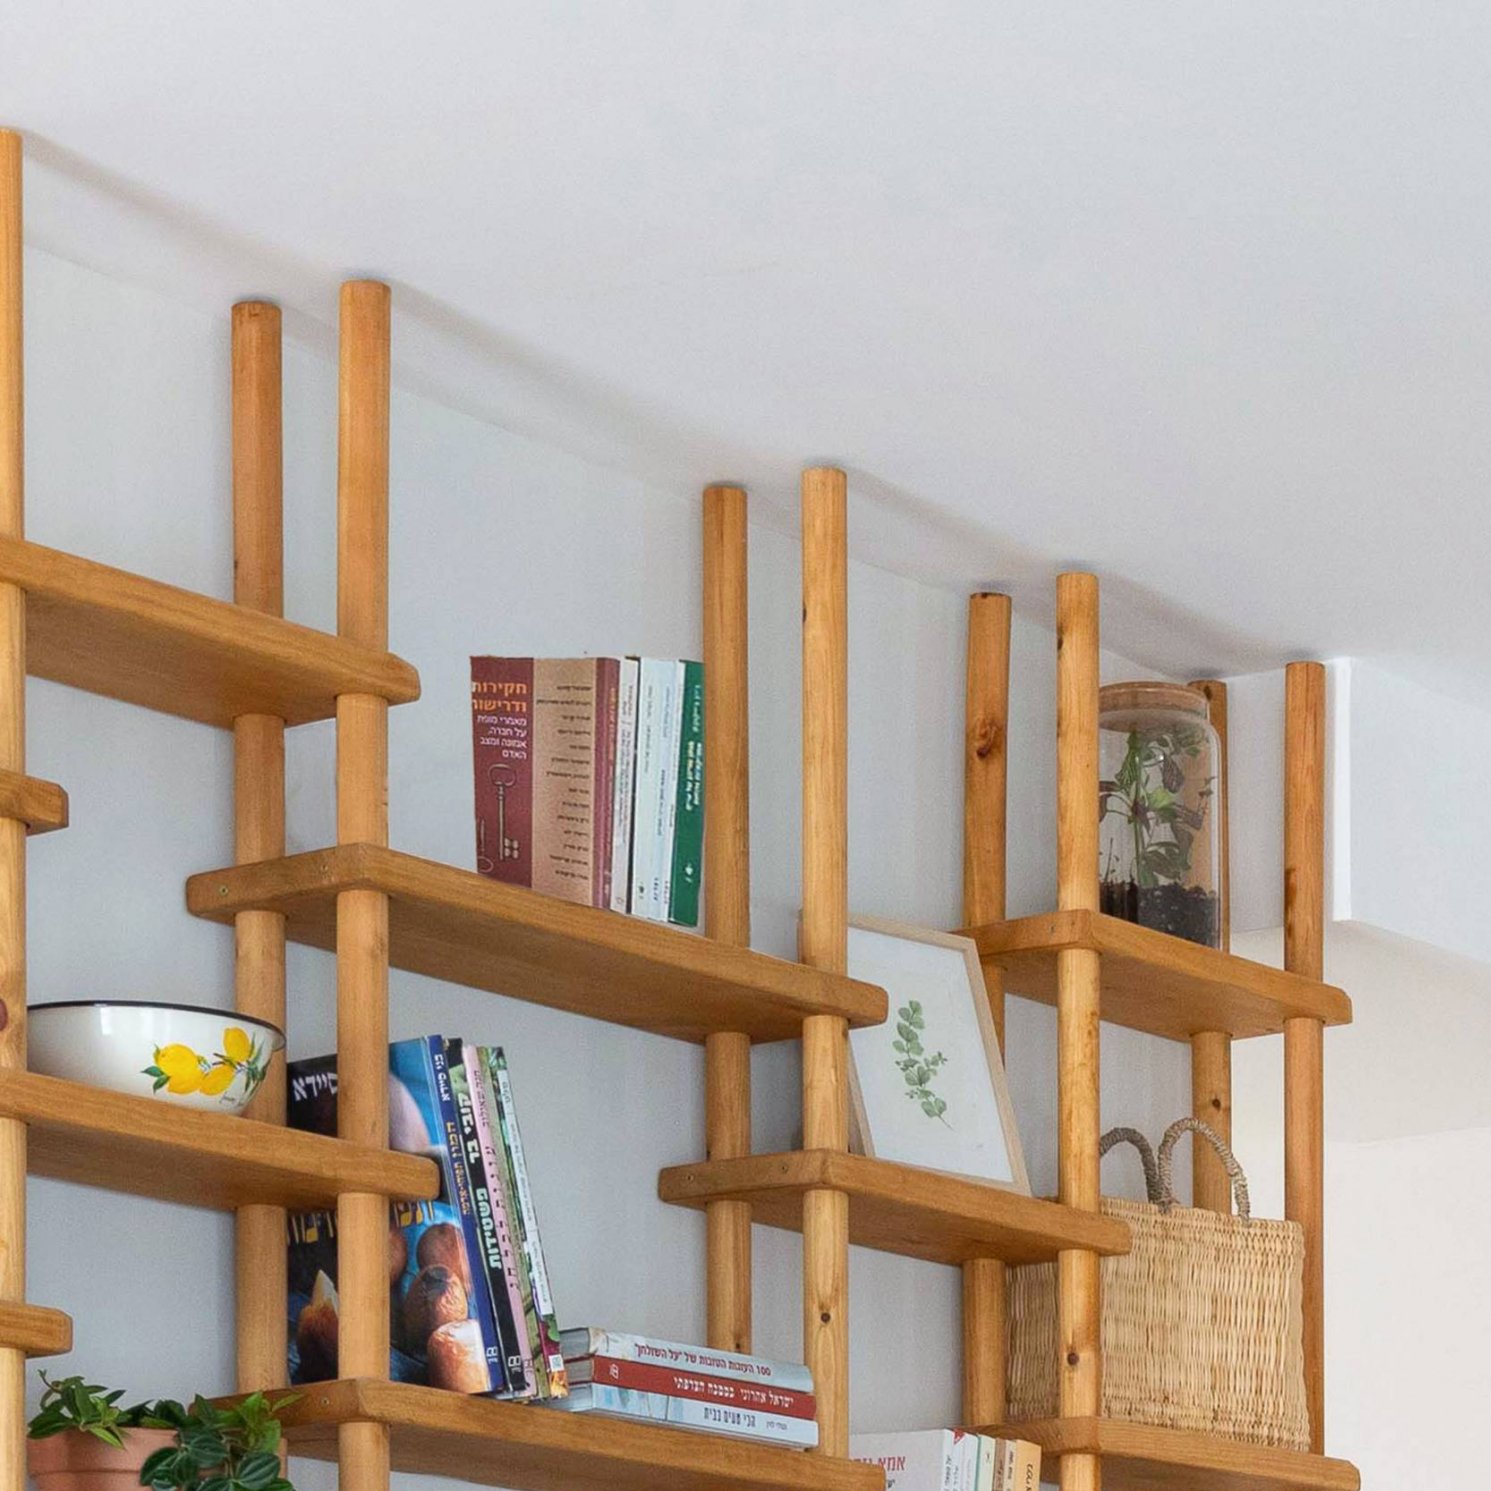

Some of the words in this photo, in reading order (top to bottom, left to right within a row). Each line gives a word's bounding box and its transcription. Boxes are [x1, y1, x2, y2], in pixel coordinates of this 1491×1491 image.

[471, 682, 527, 697] חקירות
[515, 726, 527, 738] על
[501, 749, 527, 760] האדם
[434, 1053, 445, 1070] בני
[437, 1072, 451, 1102] סיידא
[457, 1092, 475, 1135] קובי
[466, 1137, 480, 1164] בר
[475, 1187, 502, 1270] פשטידות
[684, 1352, 697, 1364] של
[757, 1365, 771, 1377] 100
[674, 1376, 706, 1392] הצרפתי
[740, 1387, 767, 1403] אהרוני
[768, 1390, 794, 1408] ישראל
[703, 1406, 722, 1422] בבית
